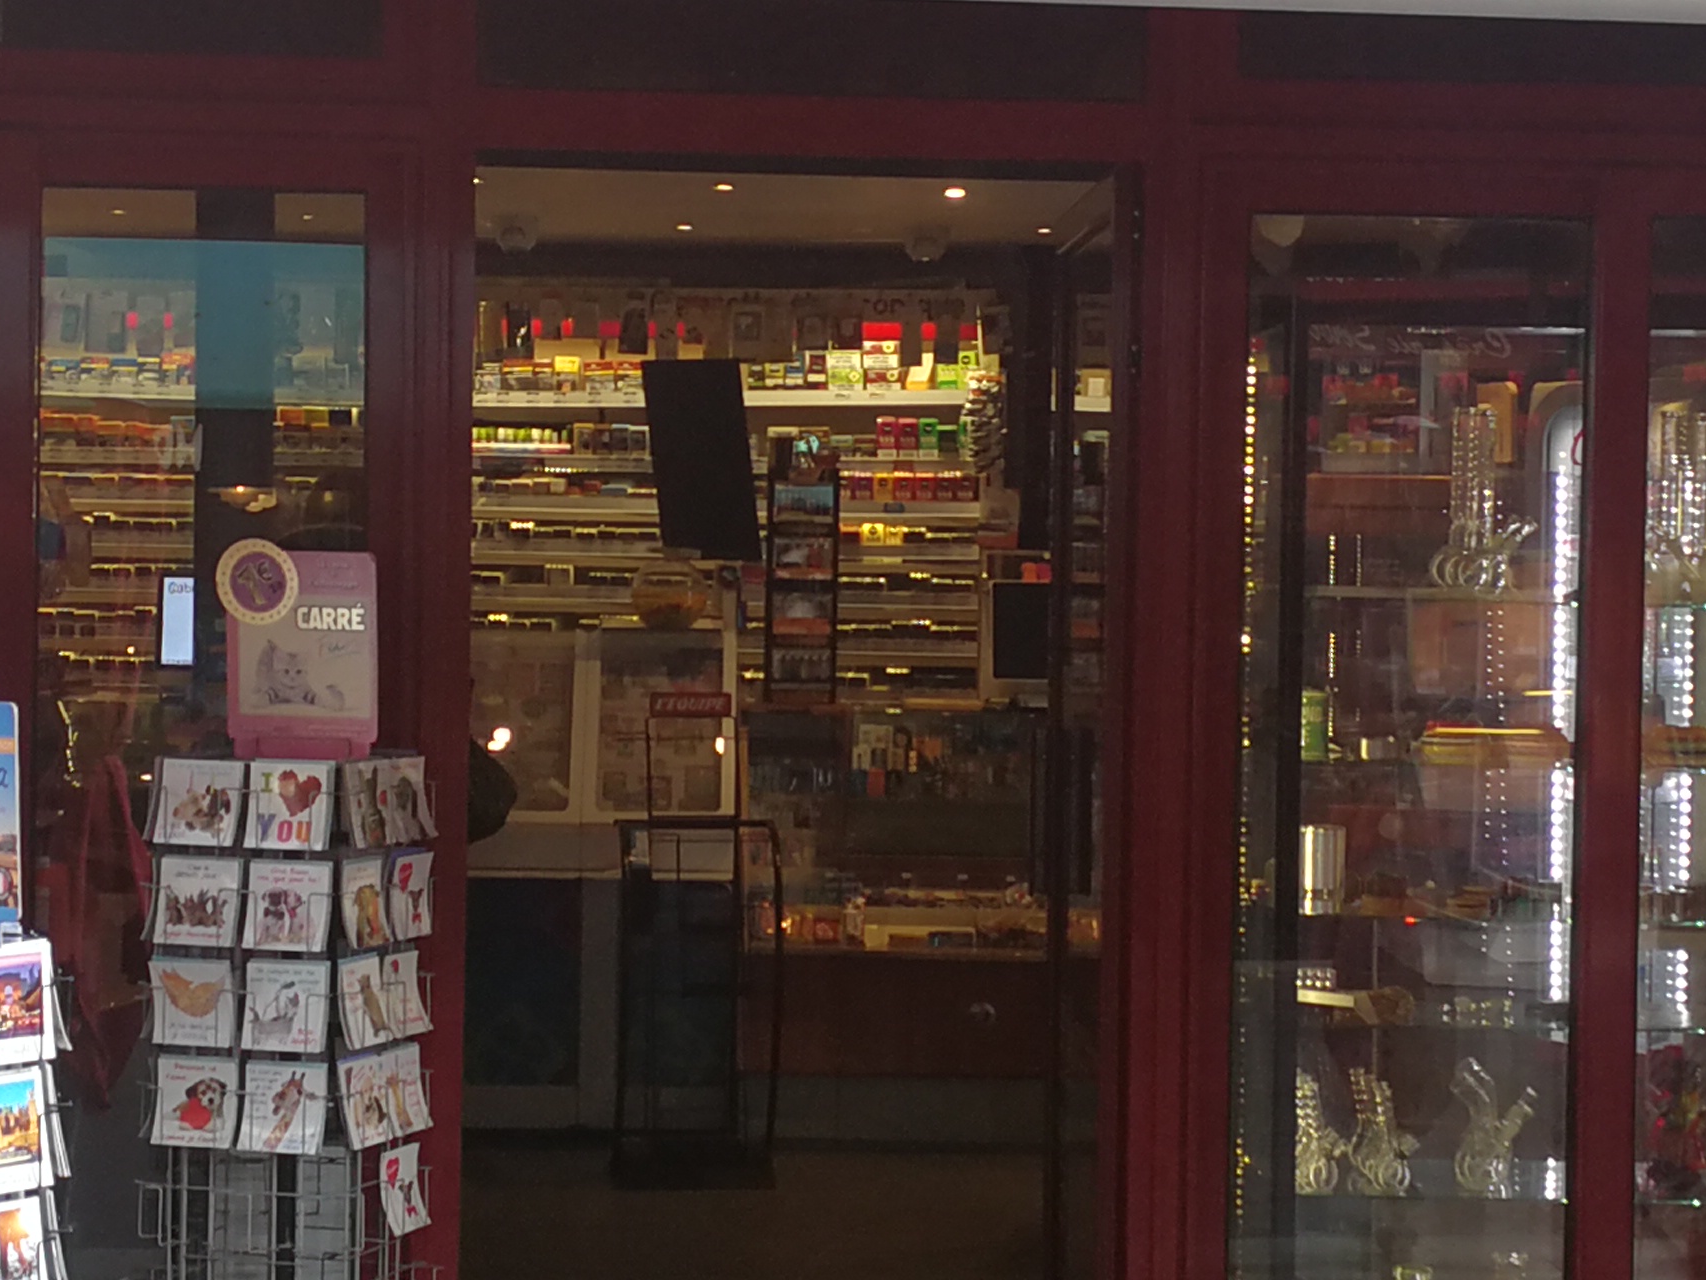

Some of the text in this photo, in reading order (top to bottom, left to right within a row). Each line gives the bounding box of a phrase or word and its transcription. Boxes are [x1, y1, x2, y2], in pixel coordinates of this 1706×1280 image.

[296, 602, 366, 631] CARRÉ
[261, 772, 274, 794] I
[258, 813, 311, 844] YOU
